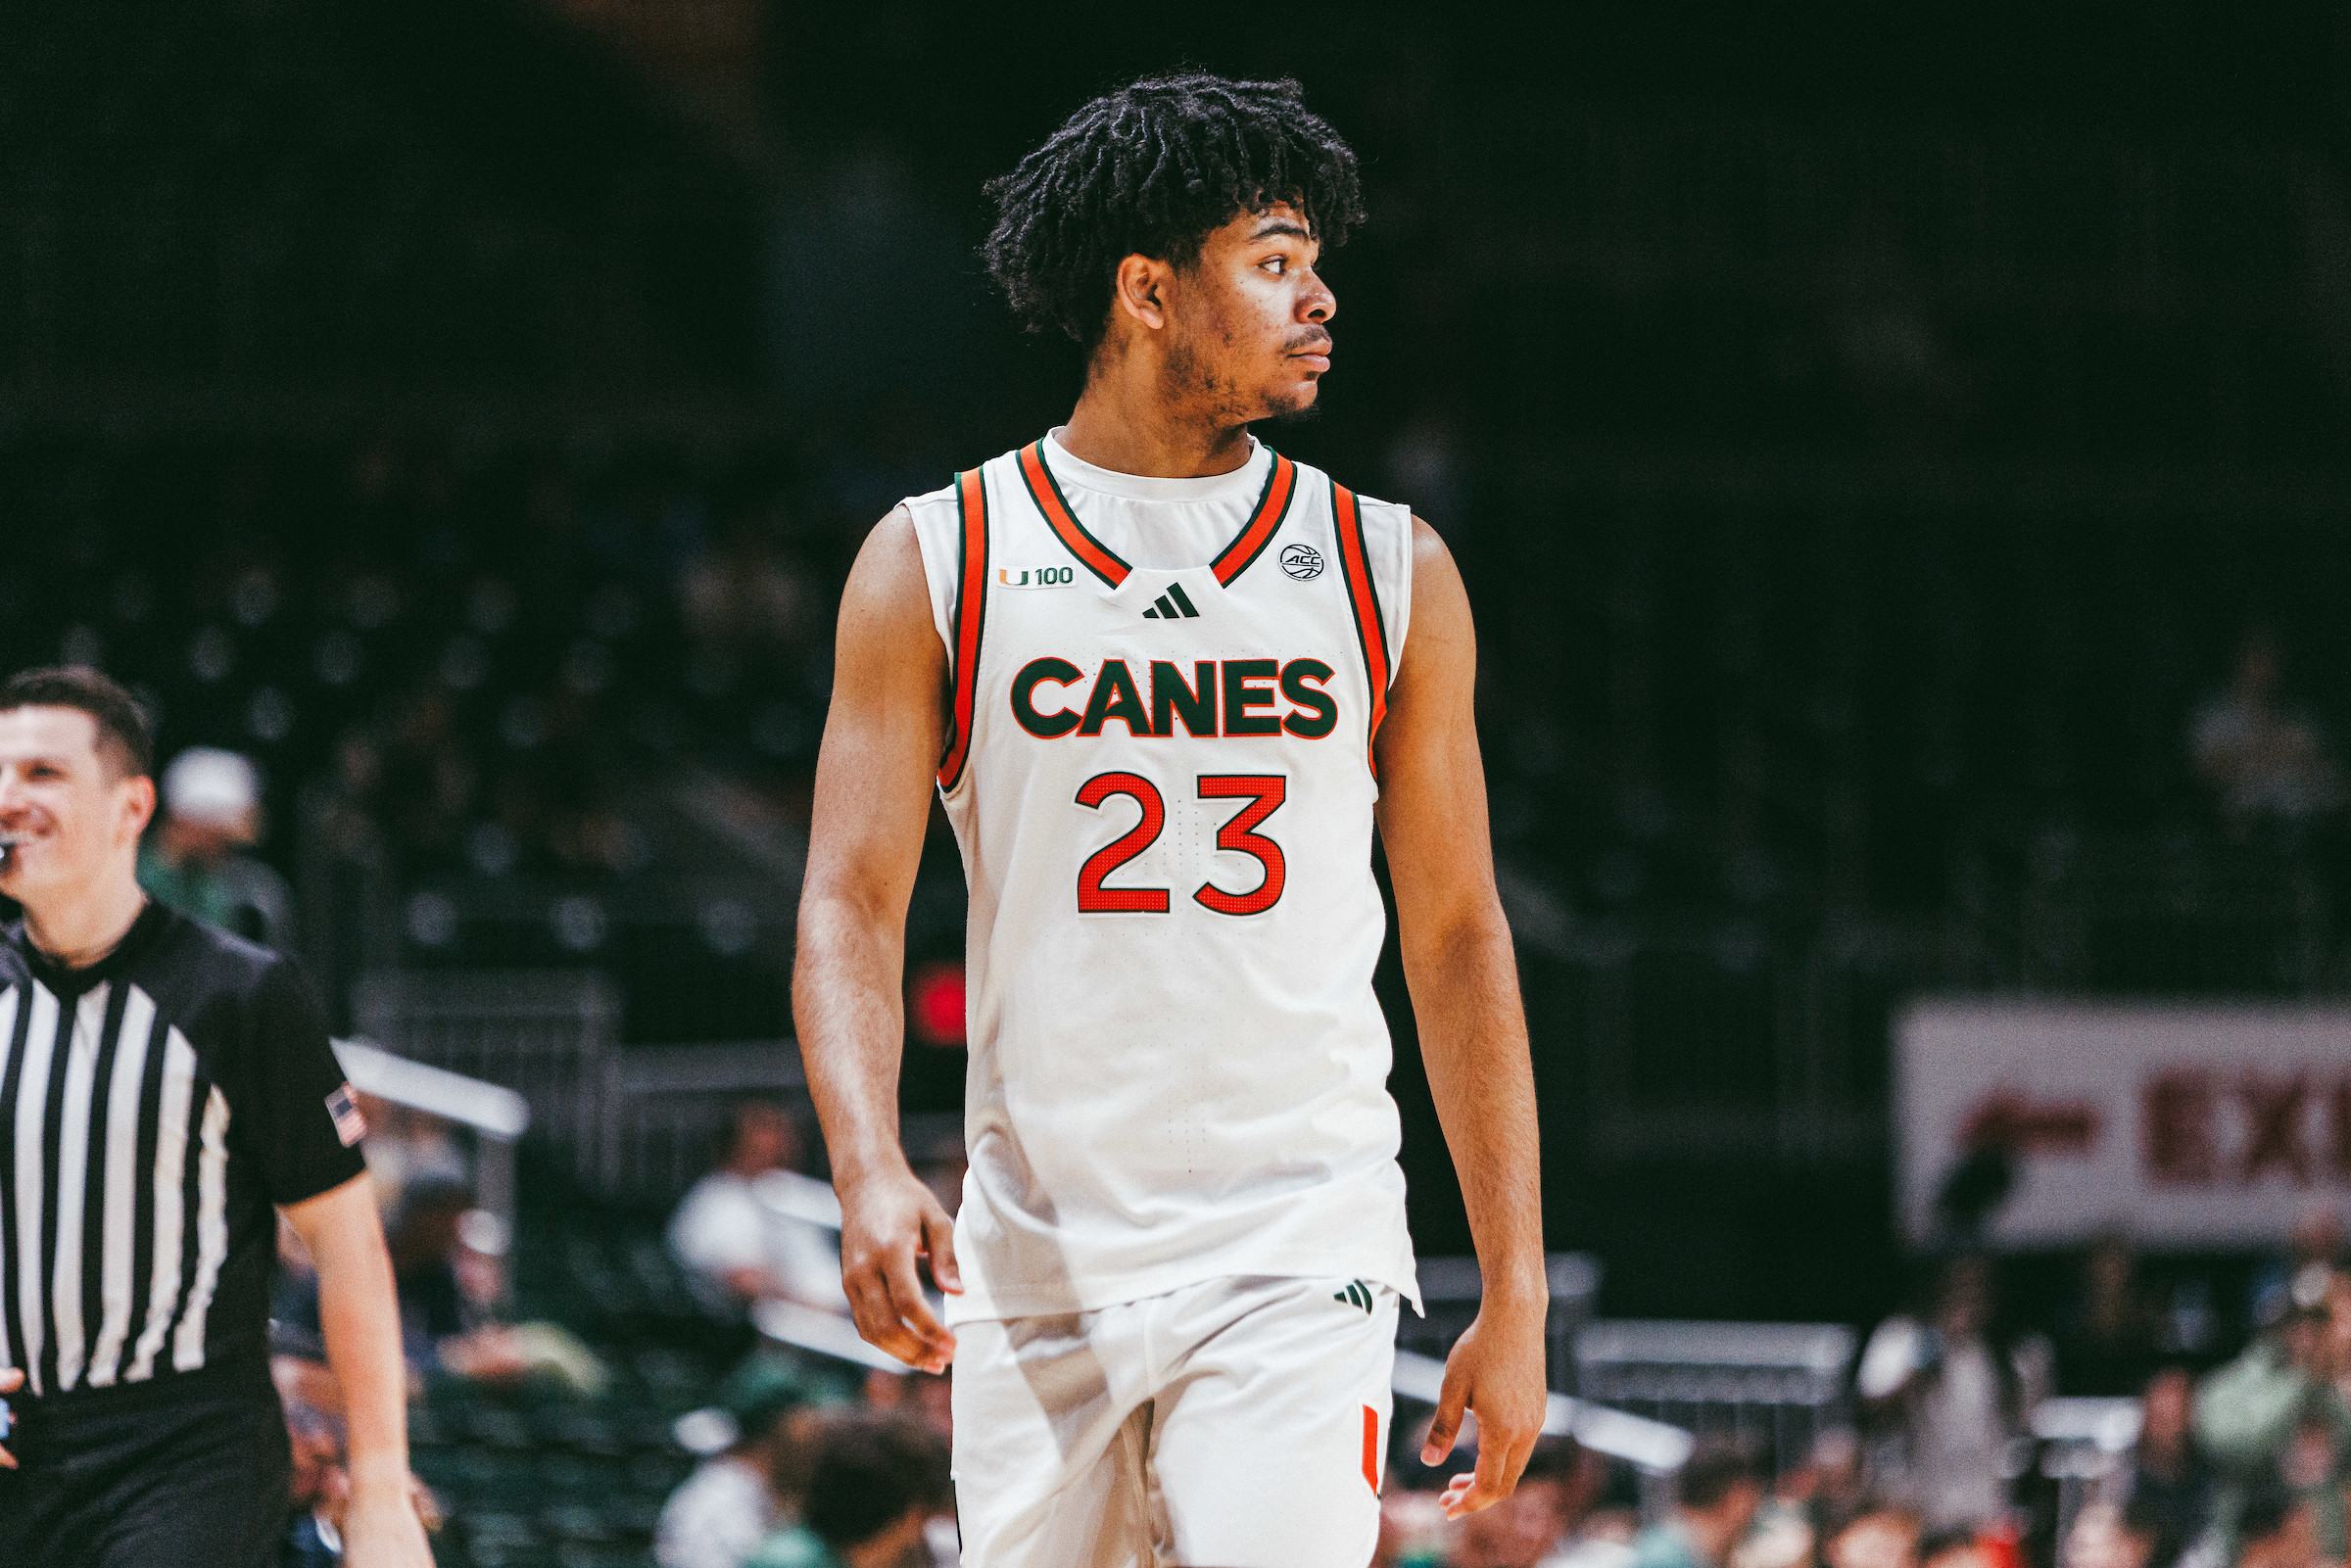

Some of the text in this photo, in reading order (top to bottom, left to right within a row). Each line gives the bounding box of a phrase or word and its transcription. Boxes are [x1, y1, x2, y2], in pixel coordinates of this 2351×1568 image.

[999, 566, 1074, 586] U 100
[1285, 555, 1321, 565] ACC
[1010, 657, 1338, 739] CANES
[1075, 771, 1286, 916] 23
